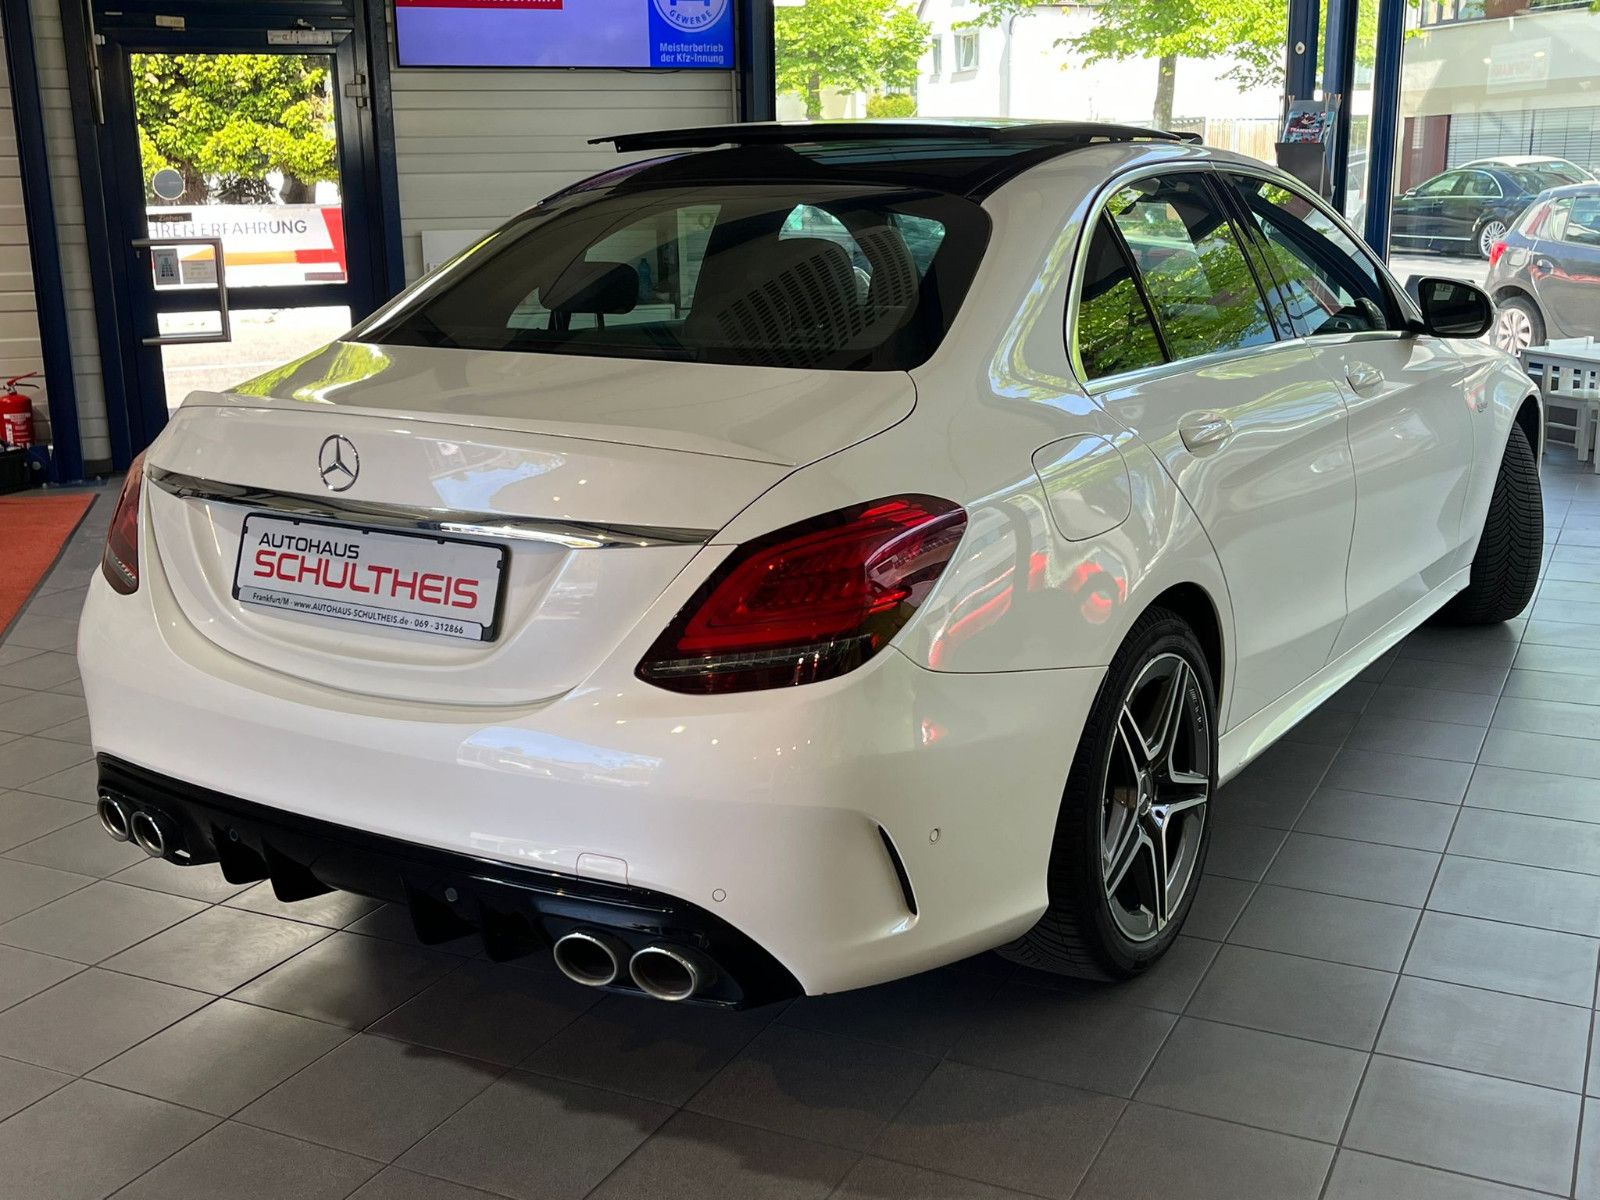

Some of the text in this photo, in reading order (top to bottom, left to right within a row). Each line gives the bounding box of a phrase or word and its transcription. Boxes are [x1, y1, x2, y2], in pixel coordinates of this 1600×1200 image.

[669, 9, 713, 25] GEWERBE
[660, 42, 724, 52] Meisterbetrieb
[660, 53, 724, 64] der Kfz-Innung
[158, 214, 184, 222] Ziehen
[201, 219, 308, 237] ERFAHRUNG
[258, 532, 360, 560] AUTOHAUS
[253, 549, 479, 610] SCHULTHEIS
[414, 618, 430, 629] 069
[434, 622, 464, 635] 312866
